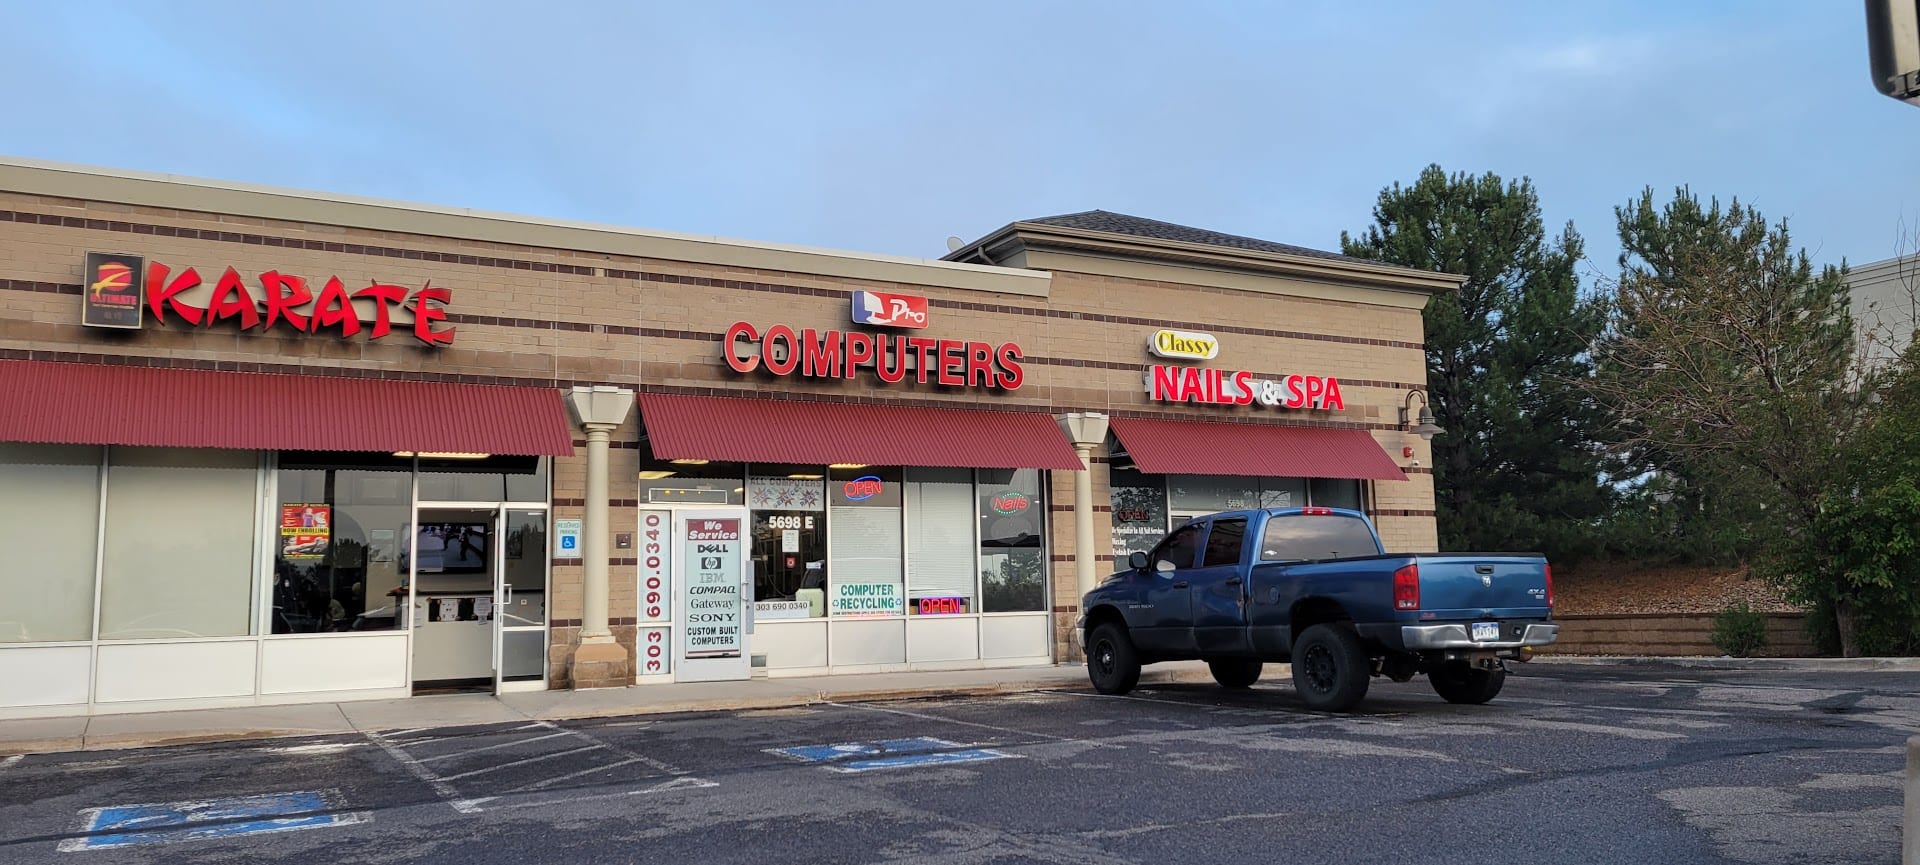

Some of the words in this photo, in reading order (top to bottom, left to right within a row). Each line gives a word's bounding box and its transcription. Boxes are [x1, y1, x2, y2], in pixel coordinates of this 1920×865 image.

[147, 261, 456, 346] KARATE
[889, 298, 926, 323] Pro
[1158, 332, 1214, 357] Classy
[723, 321, 1025, 391] COMPUTERS
[1153, 364, 1254, 406] NAILS
[1260, 380, 1280, 405] &
[1285, 374, 1345, 410] SPA
[844, 480, 883, 496] OPEN
[993, 497, 1028, 510] Nails
[703, 520, 723, 531] We
[768, 515, 801, 529] 5698
[804, 515, 814, 529] E
[688, 530, 738, 540] Service
[697, 544, 729, 553] DELL
[645, 514, 661, 618] 690.0340
[699, 573, 725, 584] IBM
[689, 585, 736, 595] COMPAQ
[840, 584, 894, 596] COMPUTER
[690, 598, 734, 609] Gateway
[755, 603, 771, 611] 303
[772, 603, 787, 611] 690
[788, 602, 808, 610] 0340
[839, 597, 895, 610] RECYCLING
[921, 598, 960, 614] OPEN
[689, 613, 736, 622] SONY
[687, 626, 717, 636] CUSTOM
[719, 626, 739, 635] BUILT
[691, 636, 734, 646] COMPUTERS
[646, 631, 662, 671] 303
